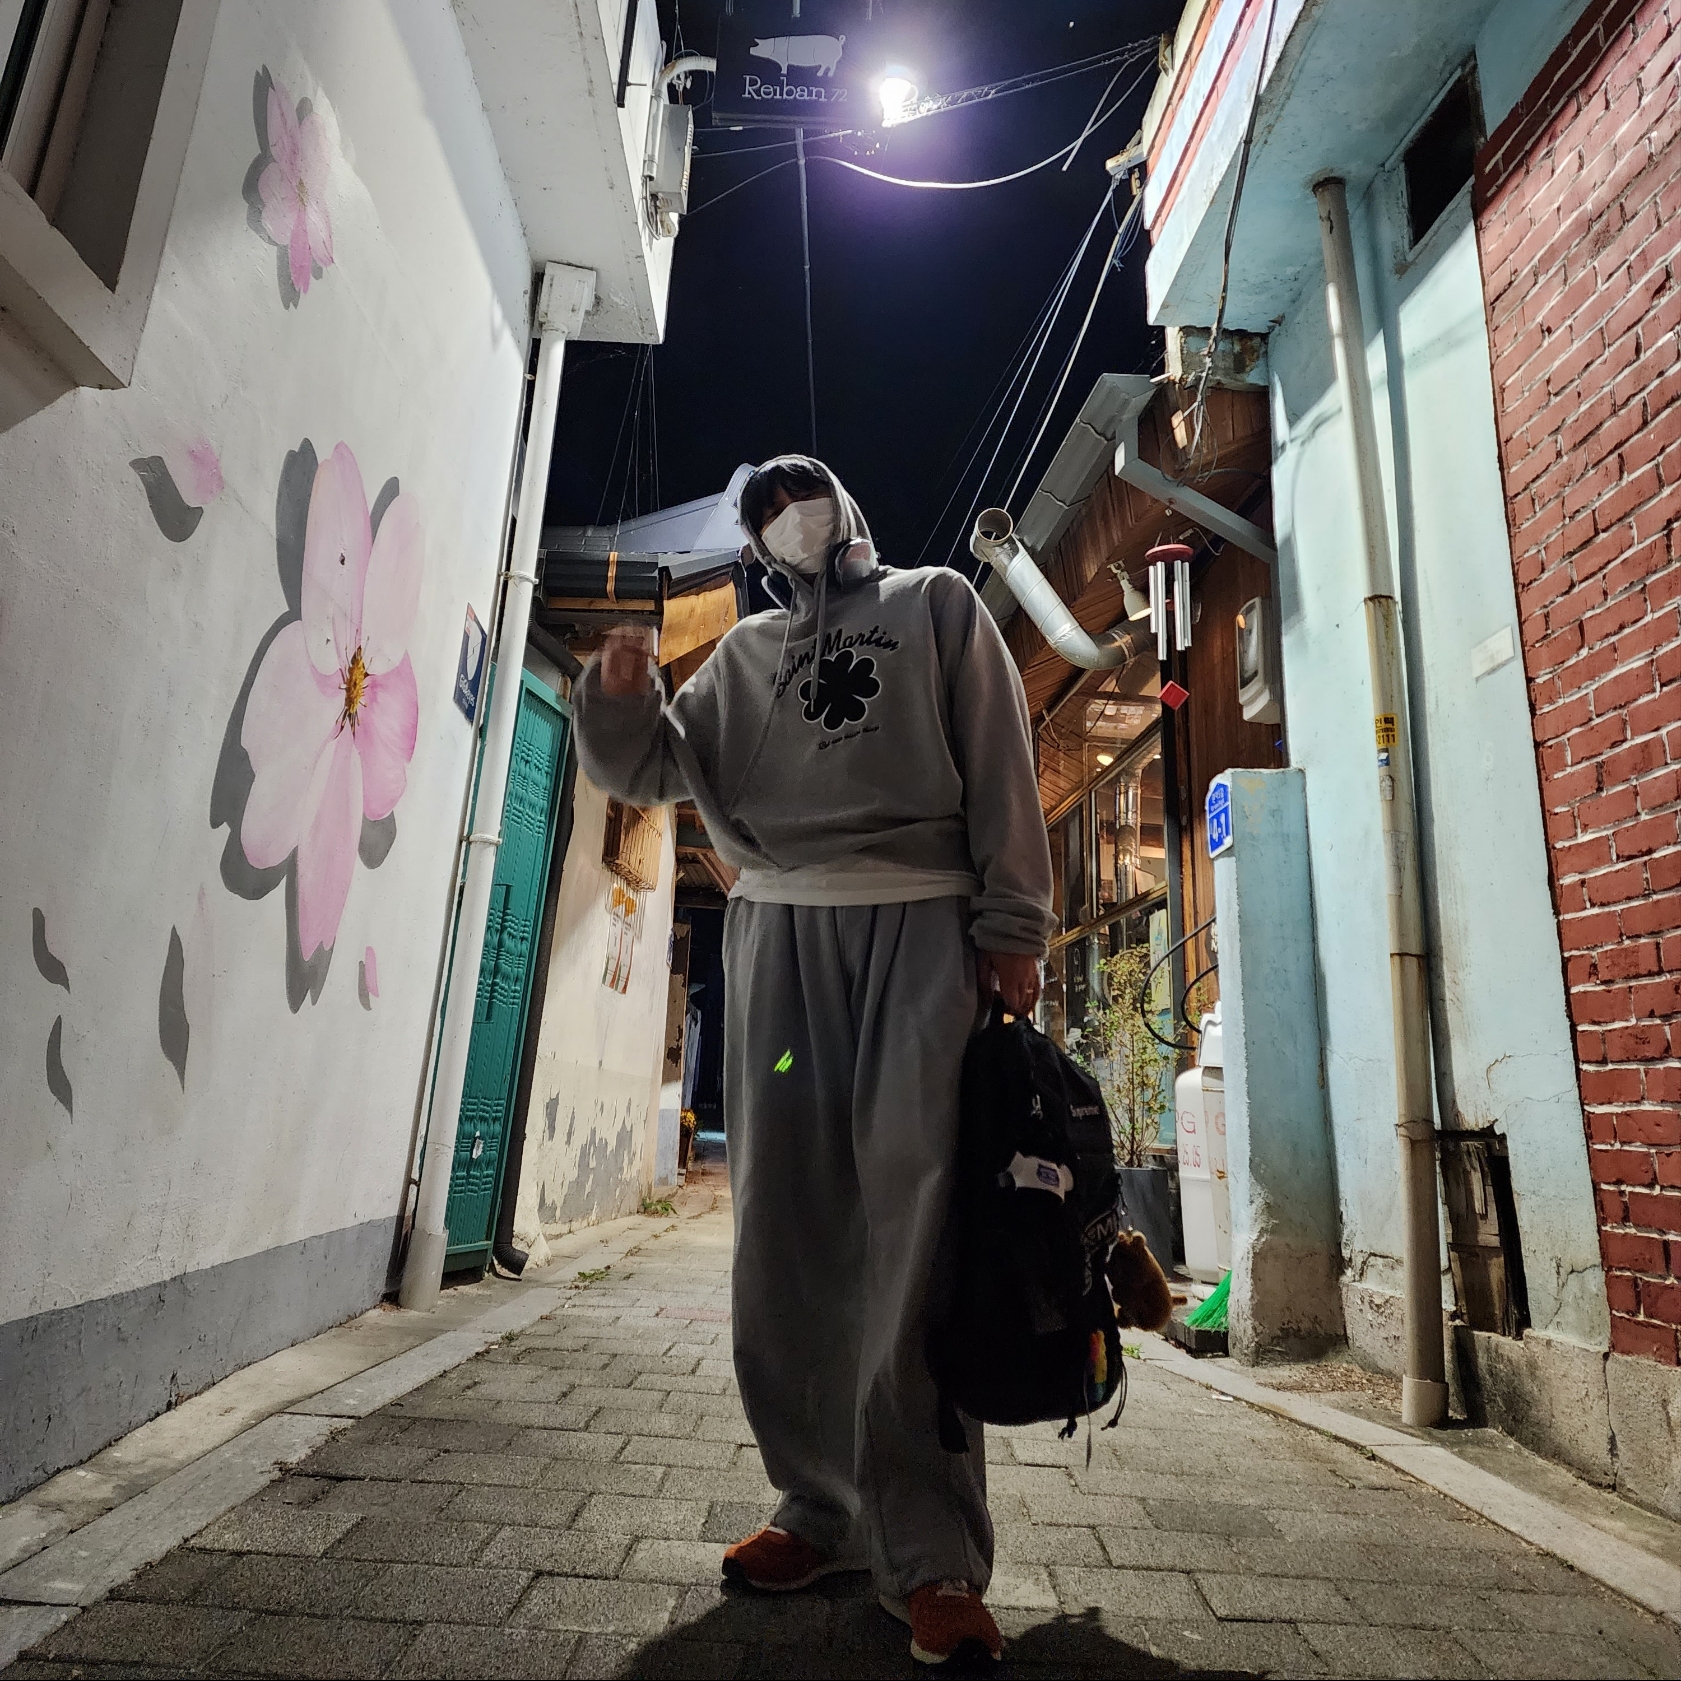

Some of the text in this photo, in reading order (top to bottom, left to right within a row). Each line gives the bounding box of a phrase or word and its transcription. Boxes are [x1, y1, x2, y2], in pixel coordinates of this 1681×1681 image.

[742, 75, 848, 101] Reiban 72
[820, 625, 900, 657] Martin
